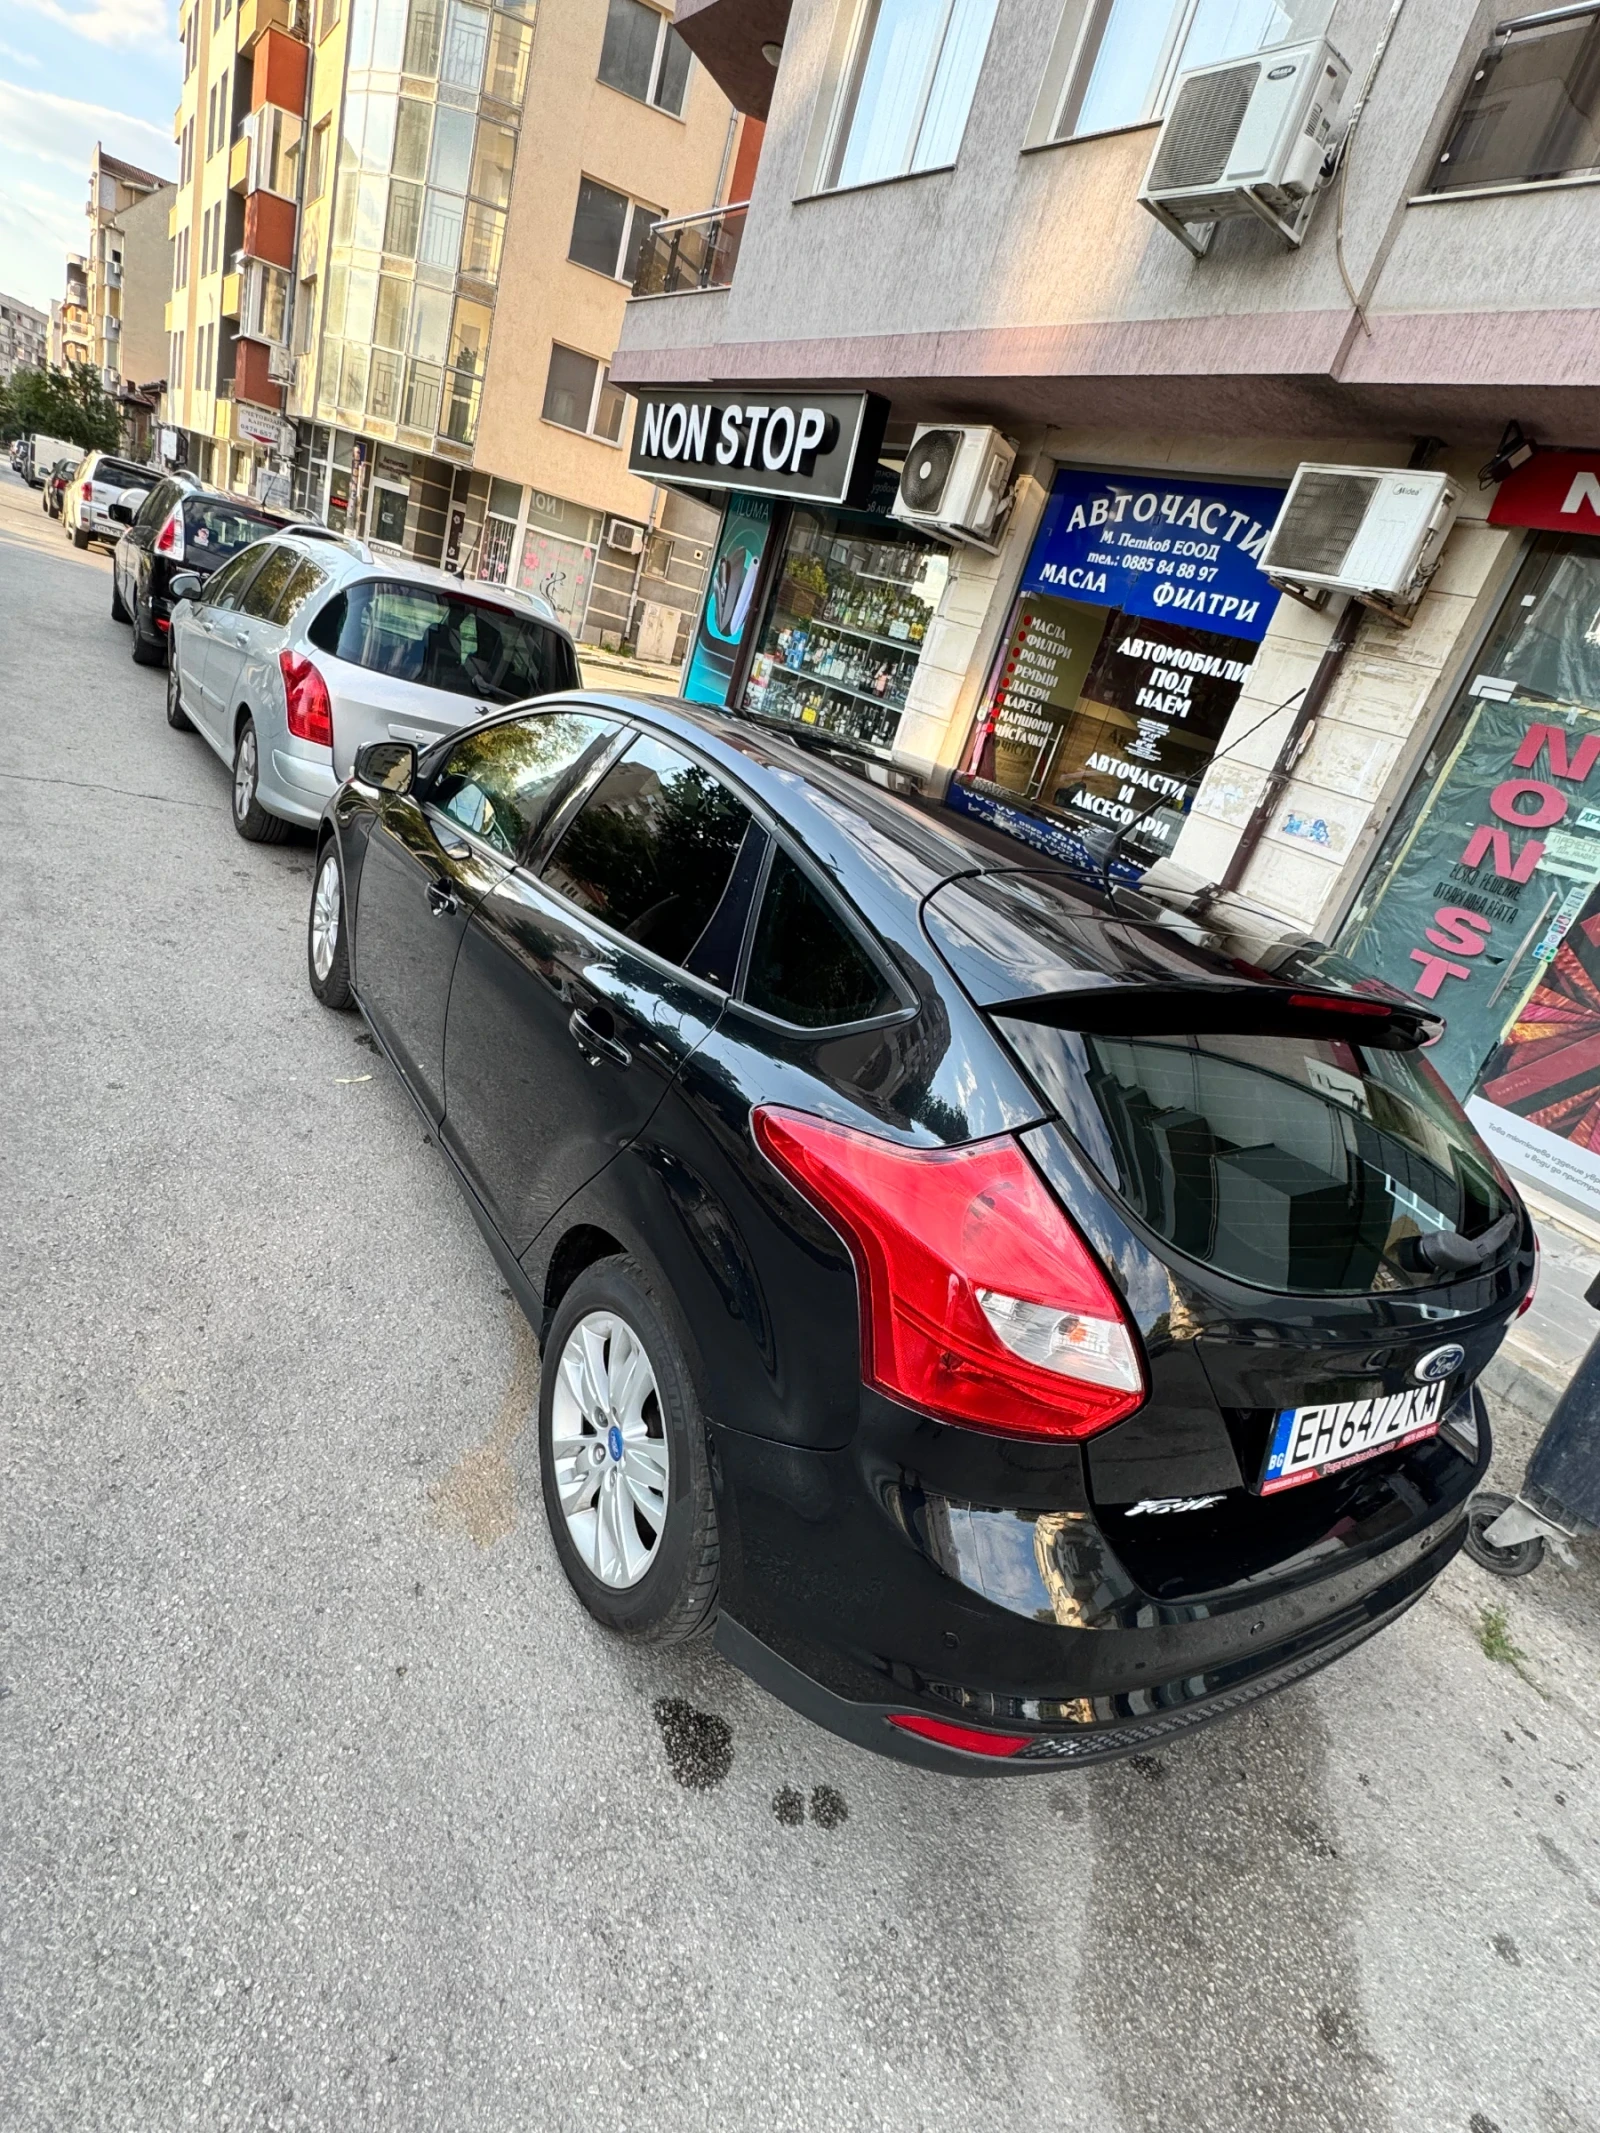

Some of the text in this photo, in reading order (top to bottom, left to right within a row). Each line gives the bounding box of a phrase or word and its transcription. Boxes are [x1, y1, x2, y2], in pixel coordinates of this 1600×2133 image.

[640, 402, 826, 472] NON STOP
[736, 499, 770, 521] ILUMA
[1066, 493, 1272, 560] АВТОЧАСТИ
[1099, 531, 1221, 562] М. Петков ЕООД
[1039, 562, 1107, 593] МАСЛА
[1087, 552, 1219, 583] тел.: 0885 84 88 97
[1153, 581, 1260, 623] ФИЛТРИ
[1031, 616, 1067, 641] МАСЛА
[1026, 634, 1073, 659] ФИЛТРИ
[1020, 648, 1057, 671] РОЛКИ
[1116, 637, 1252, 684] АВТОМОБИЛИ
[1014, 664, 1059, 688] РЕМЪЦИ
[1149, 667, 1194, 697] ПОД
[1009, 680, 1051, 701] ЛАГЕРИ
[1135, 687, 1193, 718] НАЕМ
[1003, 693, 1042, 716] КАРЕТА
[998, 708, 1054, 734] МАНШОНИ
[995, 723, 1047, 748] ЧИСТАЧКИ
[1085, 752, 1188, 800] АВТОЧАСТИ
[1118, 784, 1136, 804] И
[1488, 1122, 1505, 1136] Това
[1551, 1155, 1585, 1176] изделие
[1531, 1154, 1550, 1169] води
[1551, 1166, 1561, 1174] до
[1429, 1352, 1460, 1376] Ford
[1267, 1452, 1285, 1471] BG
